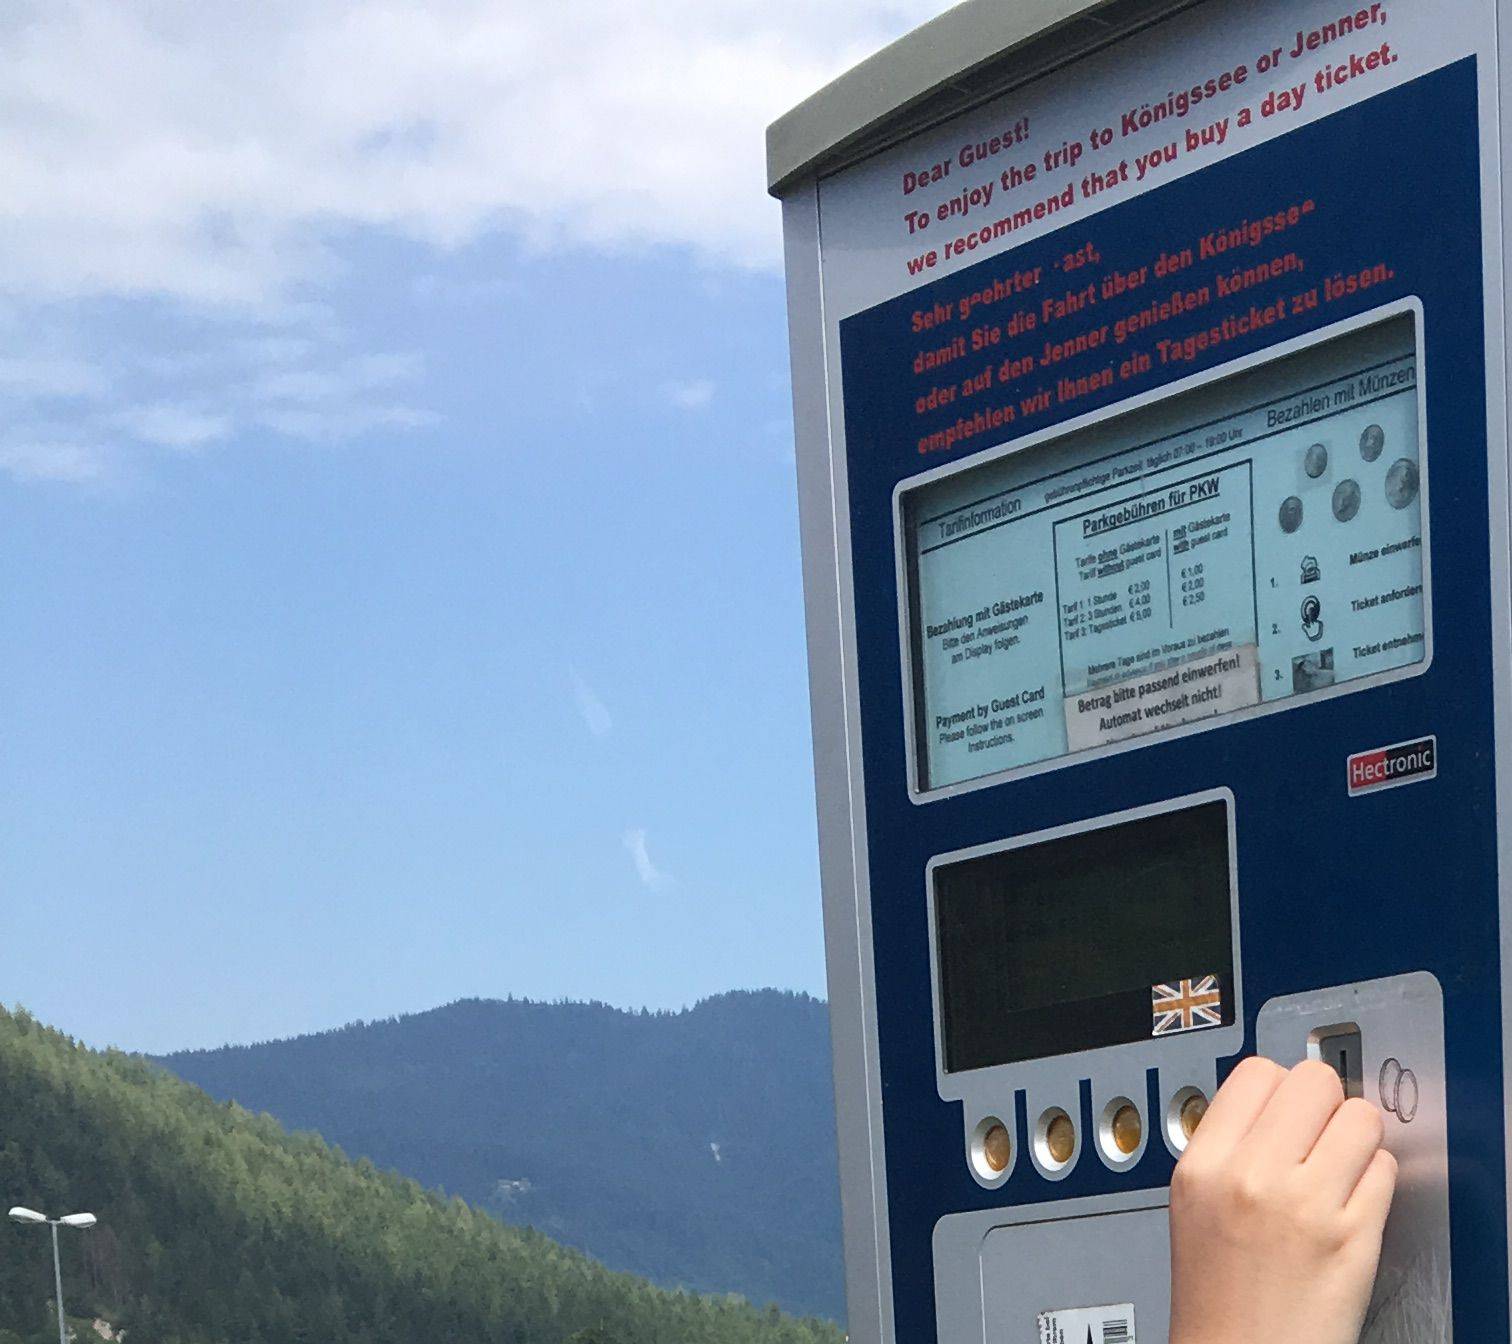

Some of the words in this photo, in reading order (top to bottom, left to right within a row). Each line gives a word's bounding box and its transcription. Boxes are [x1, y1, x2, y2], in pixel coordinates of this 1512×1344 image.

[904, 211, 930, 234] To
[937, 182, 994, 220] enjoy
[1000, 163, 1037, 192] the
[1044, 142, 1083, 172] trip
[1089, 128, 1113, 151] to
[1121, 65, 1248, 137] Königssee
[1256, 47, 1283, 73] or
[1290, 3, 1387, 58] Jenner,
[903, 159, 951, 195] Dear
[958, 118, 1030, 168] Guest!
[907, 251, 937, 275] we
[944, 183, 1074, 260] recommend
[1081, 160, 1128, 198] that
[1135, 142, 1177, 181] you
[1186, 117, 1229, 152] buy
[1237, 107, 1252, 128] a
[1260, 82, 1306, 118] day
[1314, 42, 1398, 94] ticket.
[912, 302, 953, 333] Sehr
[1053, 241, 1100, 273] ast,
[914, 336, 966, 375] damit
[971, 326, 1000, 350] Sie
[1008, 311, 1037, 338] die
[1042, 284, 1096, 323] Fahrt
[1101, 266, 1148, 299] über
[1154, 249, 1192, 277] den
[915, 383, 957, 414] oder
[962, 365, 993, 397] auf
[999, 356, 1033, 382] den
[1040, 325, 1109, 366] Jenner
[1114, 287, 1210, 343] genießen
[1216, 252, 1304, 298] können,
[918, 404, 1015, 455] empfehlen
[1019, 386, 1052, 417] wir
[1057, 367, 1113, 402] Ihnen
[1119, 351, 1151, 379] ein
[1156, 299, 1286, 364] Tagesticket
[1291, 288, 1318, 315] zu
[1324, 263, 1395, 302] lösen.
[1267, 395, 1330, 428] Bezahlen
[1334, 384, 1355, 406] mit
[1359, 366, 1416, 396] Münzen
[938, 498, 1021, 539] Tarifinformation
[1083, 499, 1165, 535] Parkgebühren
[1169, 490, 1185, 508] für
[1189, 477, 1220, 500] PKW
[1350, 550, 1379, 565] Münze
[927, 614, 973, 639] Bezahlung
[975, 606, 991, 622] mit
[992, 591, 1043, 616] Gästekarte
[1351, 596, 1379, 611] Ticket
[965, 643, 992, 659] Display
[1353, 642, 1381, 658] Ticket
[936, 707, 975, 729] Payment
[977, 704, 988, 718] by
[991, 694, 1020, 713] Guest
[1021, 686, 1045, 704] Card
[1078, 693, 1112, 714] Betrag
[1113, 687, 1136, 705] bitte
[1138, 671, 1180, 698] passend
[1181, 653, 1240, 685] einwerfen!
[1100, 707, 1143, 732] Automat
[1145, 692, 1189, 717] wechselt
[1191, 684, 1222, 706] nicht!
[939, 730, 964, 743] Please
[966, 723, 989, 736] follow
[990, 719, 1003, 730] the
[1005, 716, 1015, 726] on
[1017, 708, 1044, 723] screen
[1352, 746, 1431, 783] Hectronic
